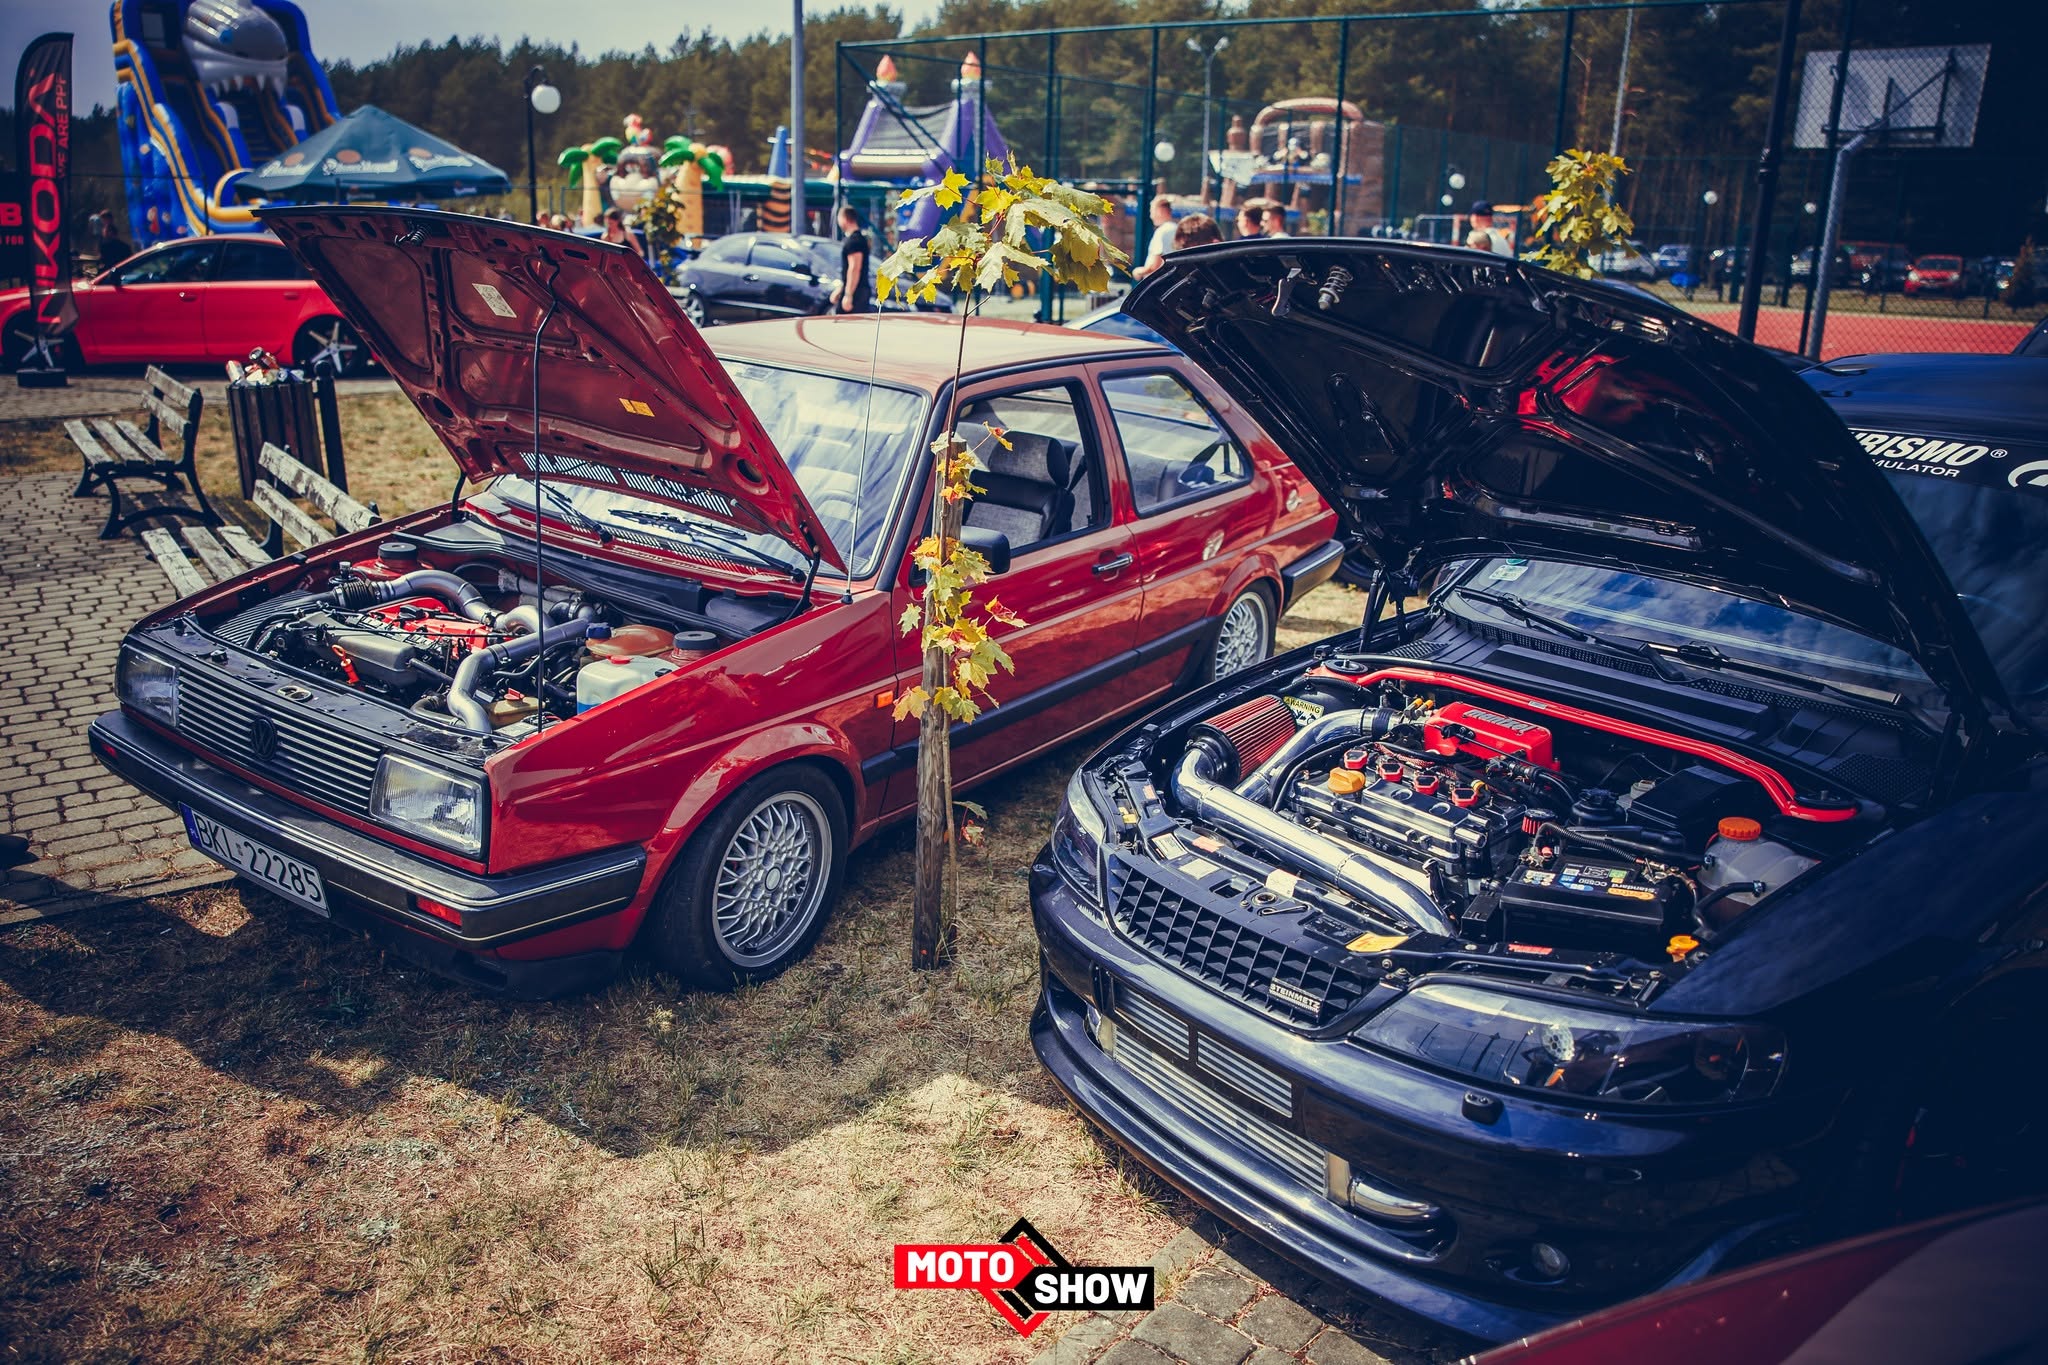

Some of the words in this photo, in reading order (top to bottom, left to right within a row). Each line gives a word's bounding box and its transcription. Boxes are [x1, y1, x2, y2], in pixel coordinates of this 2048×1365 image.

[57, 113, 69, 149] ARE
[1290, 698, 1321, 714] WARNING
[194, 813, 242, 865] BKL
[244, 841, 322, 903] 22285
[1610, 883, 1656, 895] Standard
[1269, 983, 1321, 1009] STEINMETZ
